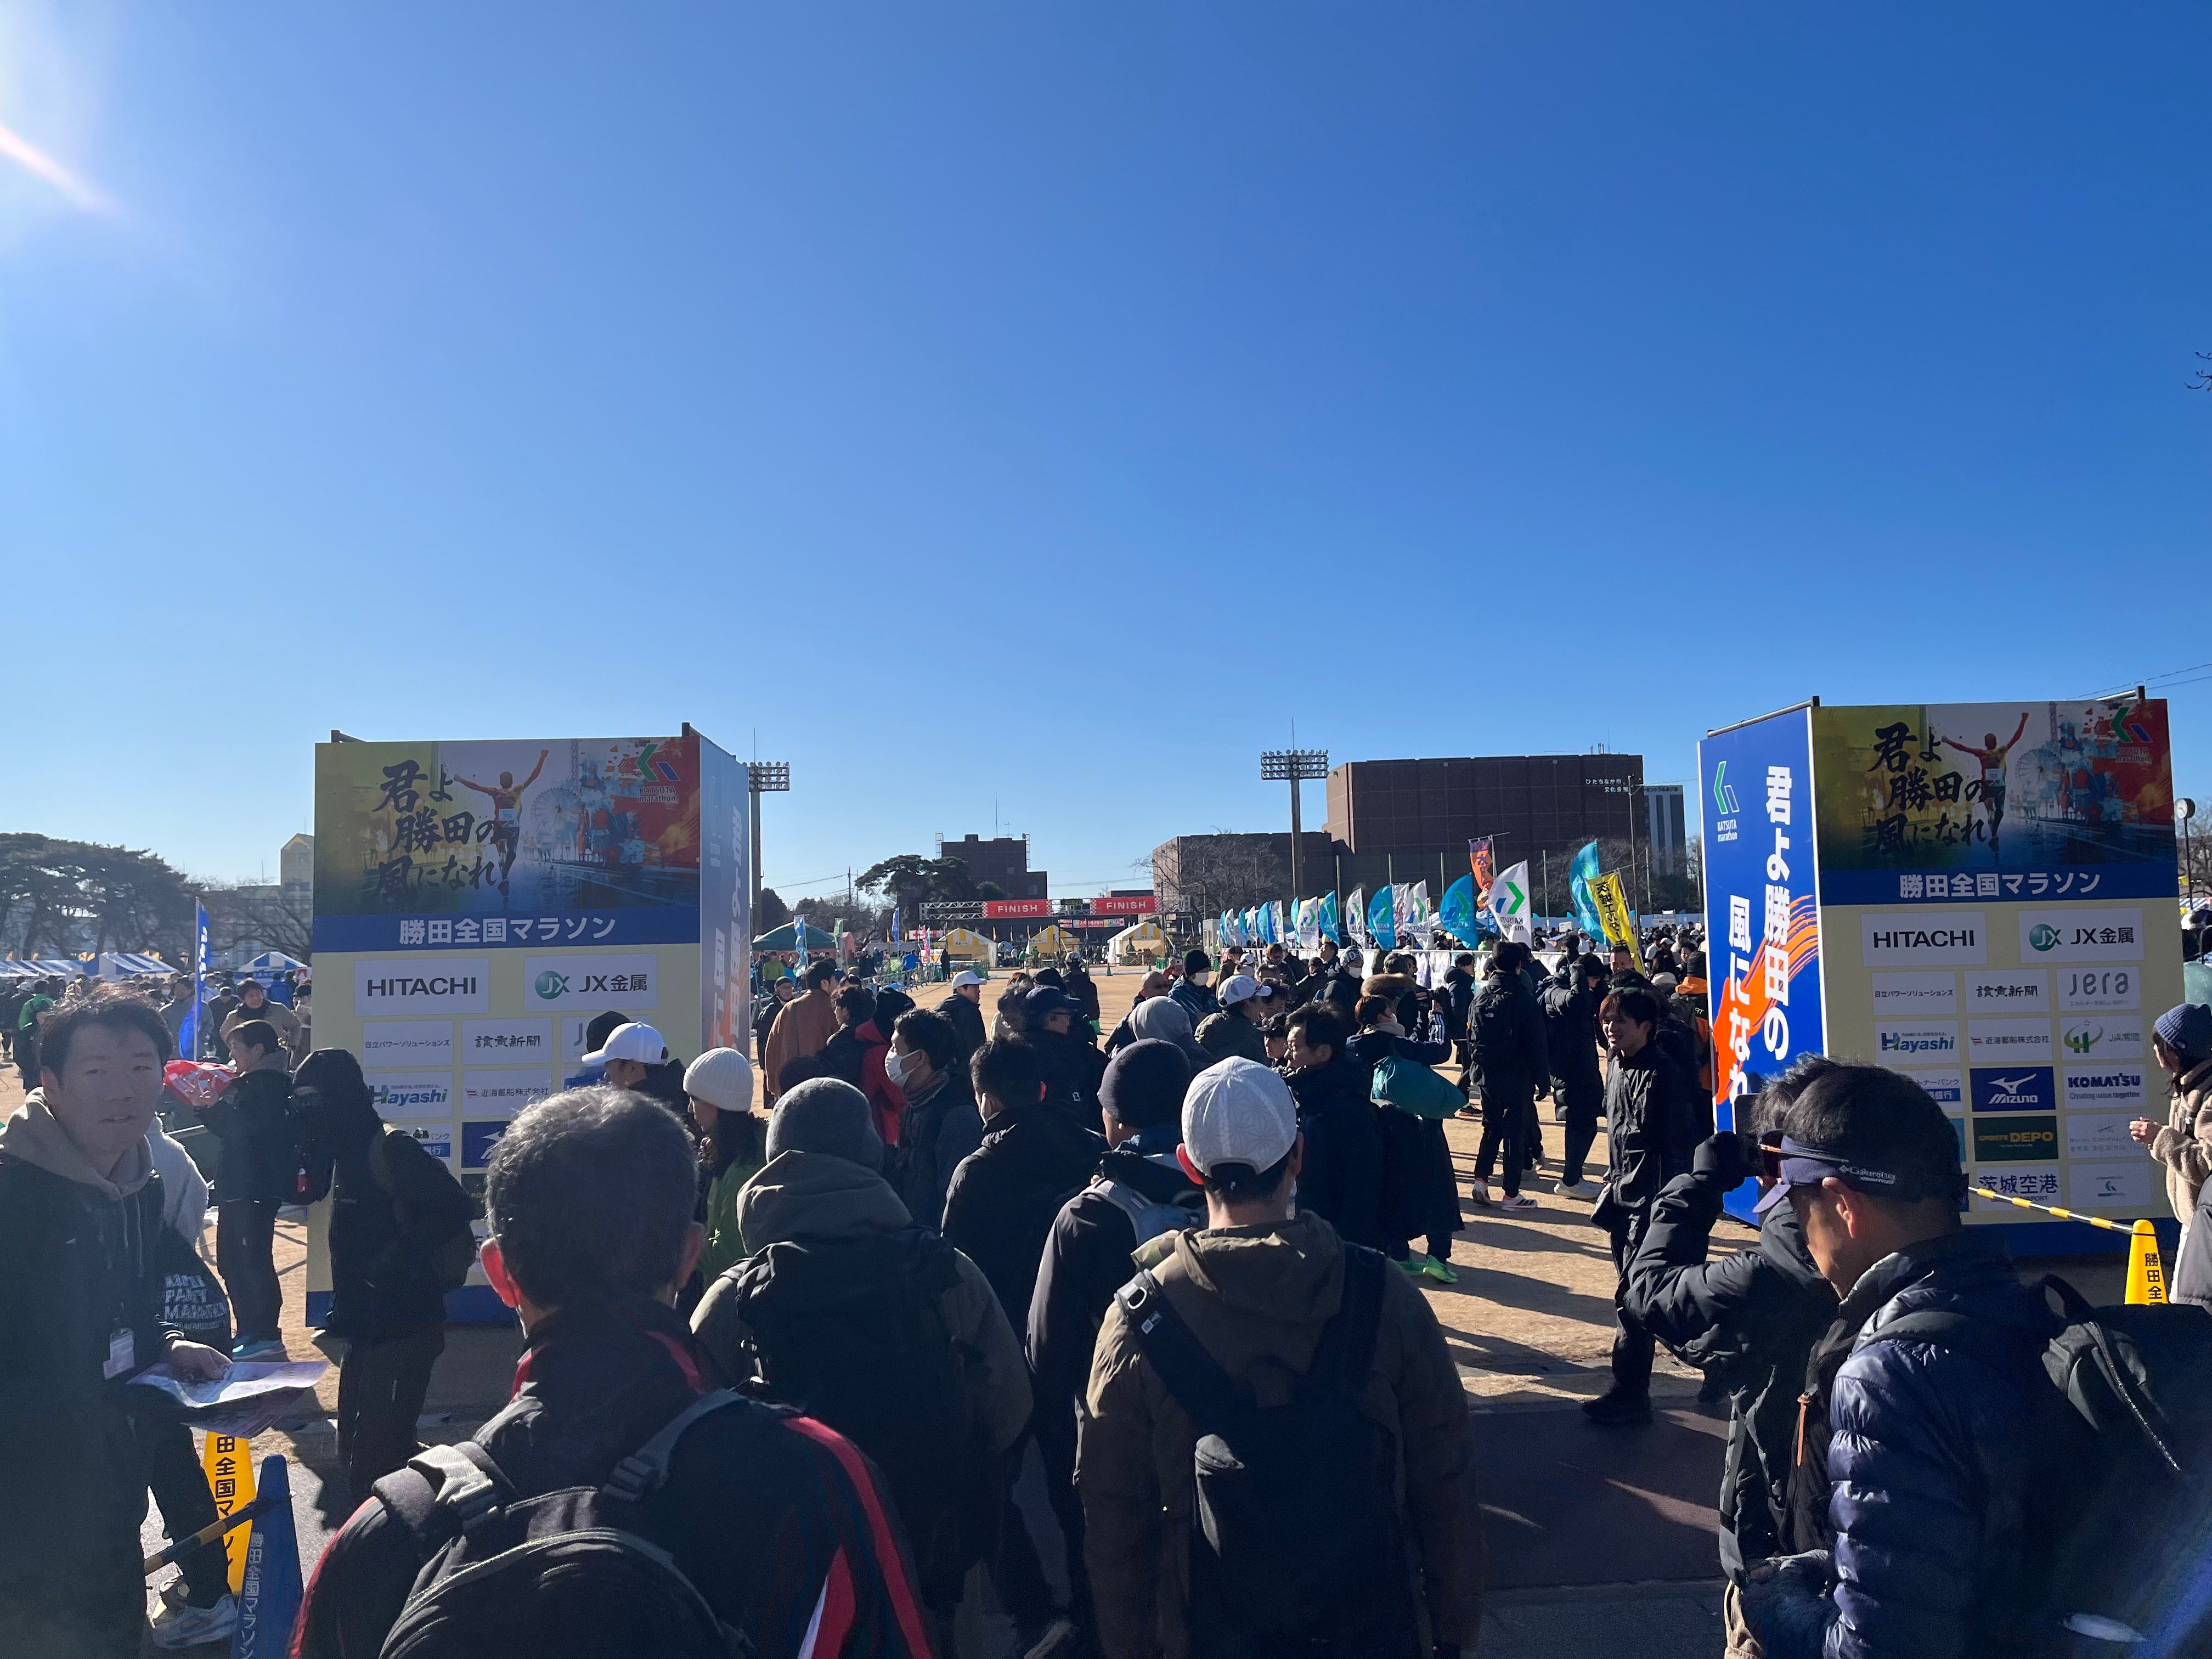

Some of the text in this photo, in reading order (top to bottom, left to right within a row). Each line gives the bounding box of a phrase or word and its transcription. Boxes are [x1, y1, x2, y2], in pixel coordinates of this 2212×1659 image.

[1867, 722, 1942, 772] 君よ
[372, 759, 454, 812] 君よ
[640, 786, 676, 794] KATSUTA
[1883, 766, 1985, 811] 勝田の
[387, 806, 496, 854] 勝田の
[1717, 819, 1737, 831] KATSUTA
[1874, 812, 1987, 854] 風になれ
[1718, 831, 1738, 842] marathon
[379, 854, 497, 898] 風になれ
[1900, 873, 2101, 898] 勝田全国マラソン
[997, 905, 1038, 913] FINISH
[1106, 901, 1147, 910] FINISH
[1764, 766, 1792, 1061] 君よ勝田の
[399, 917, 616, 945] 勝田全国マラソン
[730, 805, 742, 1047] 君よ勝田
[1873, 930, 1974, 948] HITACHI
[2070, 927, 2134, 945] JX金属
[366, 977, 476, 996] HITACHI
[579, 974, 647, 993] JX金属
[1875, 989, 1953, 997] 日立パワーソリューションズ
[365, 1039, 450, 1048] 日立パワーソリューションズ
[1881, 1032, 1955, 1053] Hayashi
[1985, 1035, 2050, 1045] 近海郵船株式会社
[2068, 1073, 2140, 1088] KOMATSU
[369, 1085, 448, 1106] Hayashi
[481, 1087, 549, 1097] 近海郵船株式会社
[2009, 1131, 2054, 1143] DEPO
[1978, 1173, 2058, 1194] 茨城空港
[2145, 1252, 2163, 1305] 勝田全
